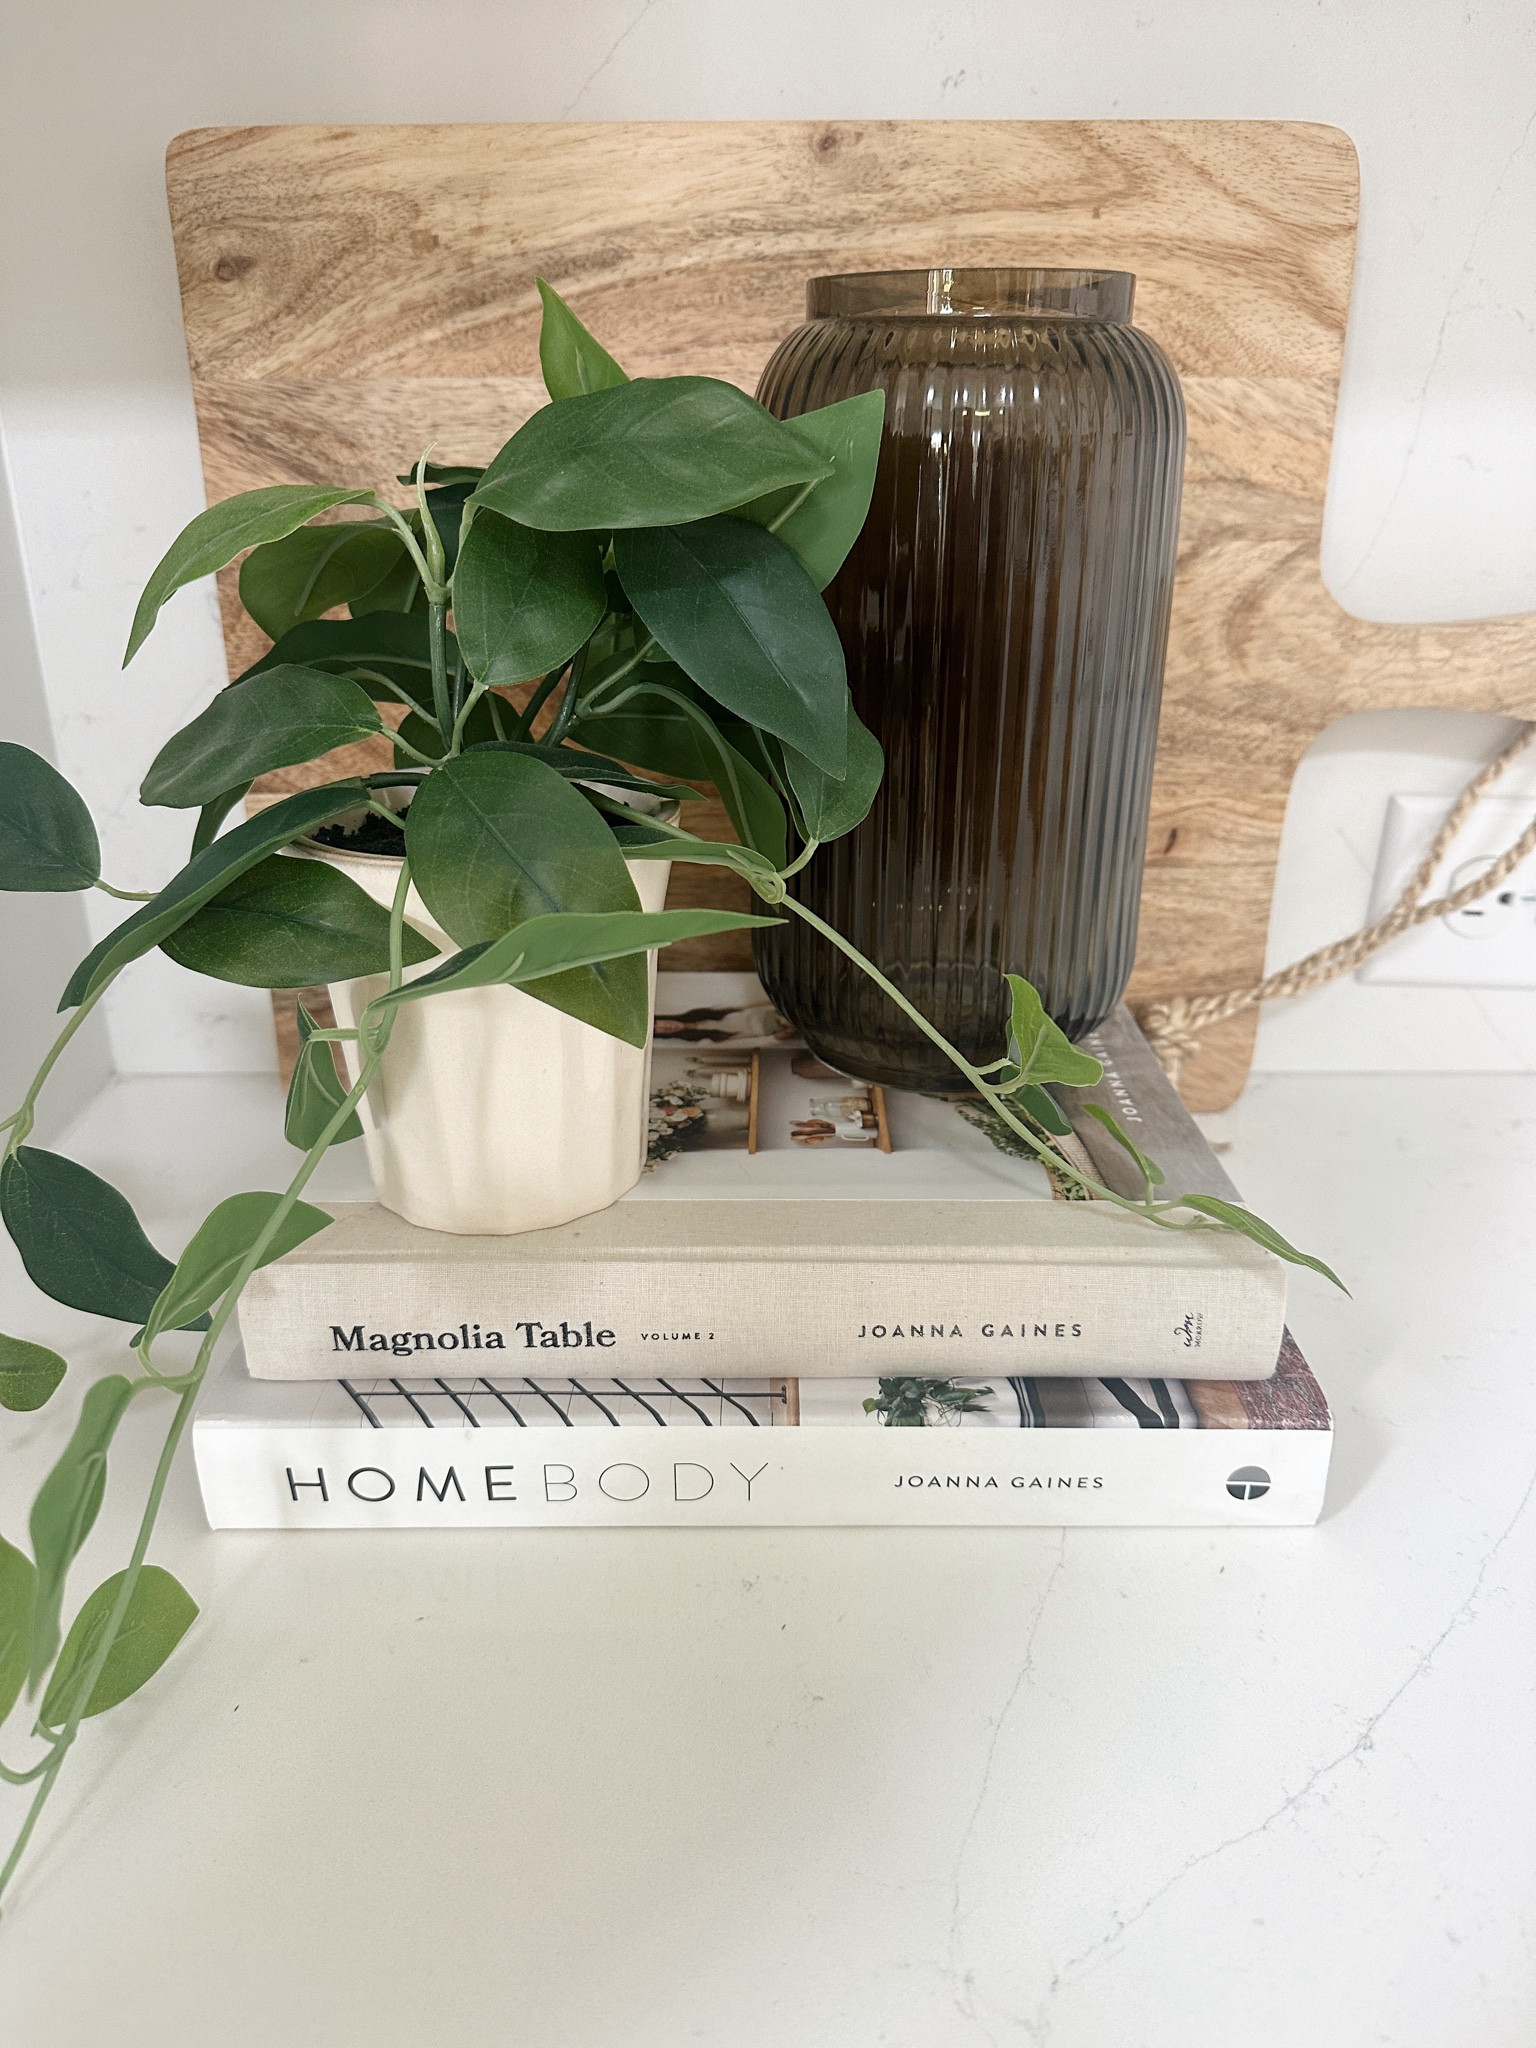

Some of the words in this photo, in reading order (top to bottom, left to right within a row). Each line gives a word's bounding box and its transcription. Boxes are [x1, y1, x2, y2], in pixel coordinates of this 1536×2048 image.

[1087, 1031, 1114, 1067] GAINE
[1104, 1071, 1143, 1122] JOANNA
[329, 1323, 506, 1357] Magnolia
[515, 1321, 617, 1349] Table
[640, 1332, 701, 1341] VOLUME
[708, 1332, 716, 1340] 2
[857, 1323, 963, 1339] JOANNA
[981, 1323, 1083, 1339] GAINES
[894, 1475, 999, 1489] JOANNA
[1010, 1475, 1104, 1489] GAINES
